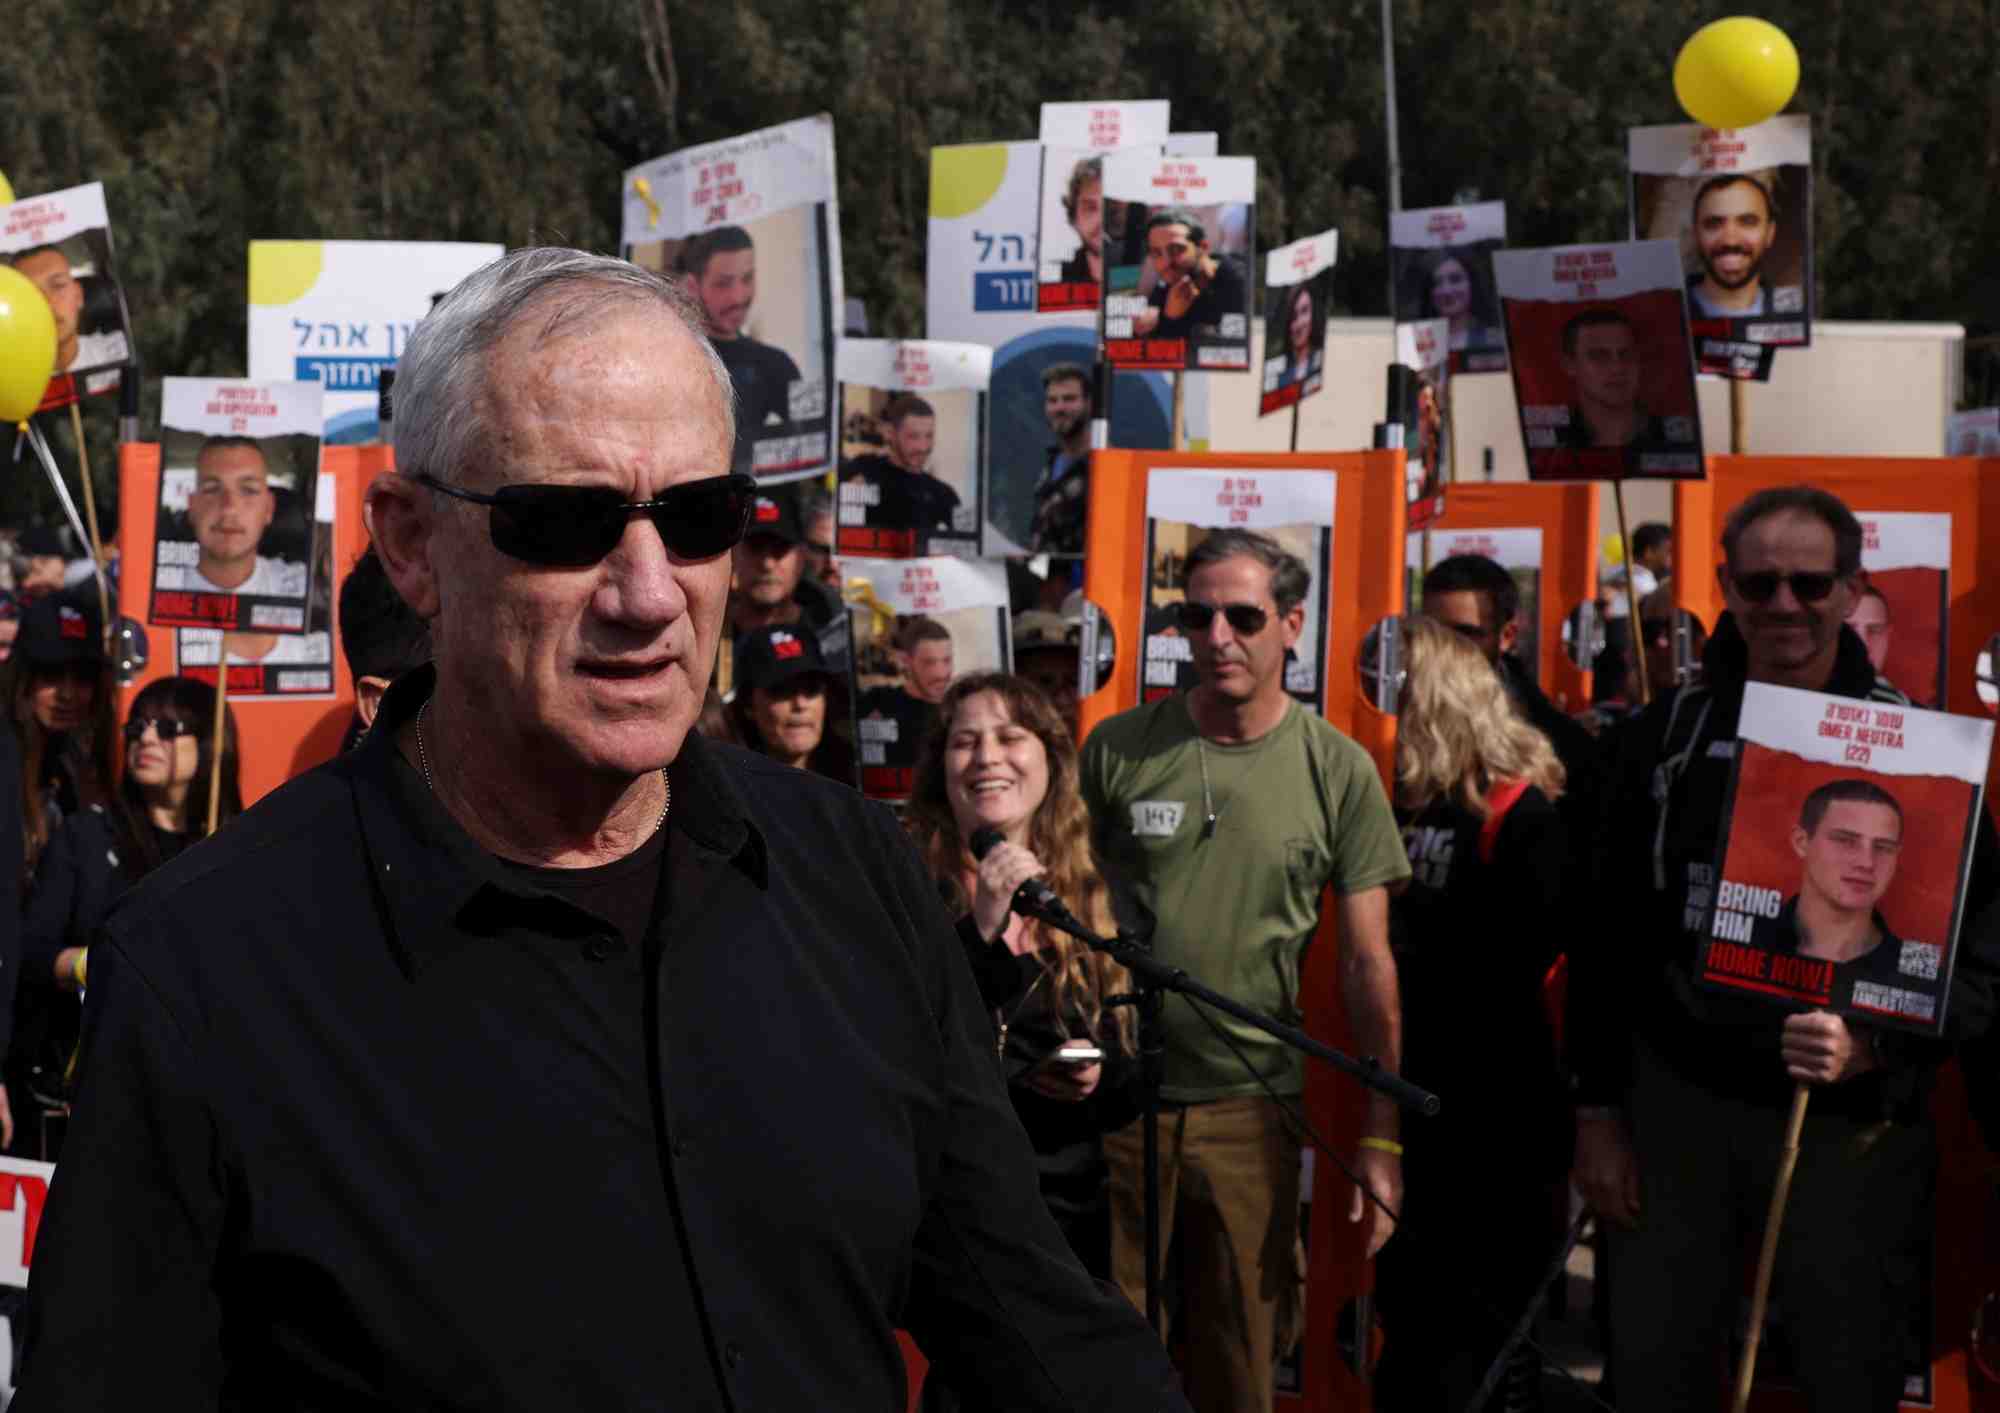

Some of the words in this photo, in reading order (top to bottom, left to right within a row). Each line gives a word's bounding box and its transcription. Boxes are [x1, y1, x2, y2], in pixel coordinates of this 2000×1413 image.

[293, 317, 368, 348] אהל
[1818, 720, 1852, 738] OMER
[1856, 728, 1905, 749] NEUTRA
[1717, 880, 1782, 919] BRING
[1712, 909, 1754, 944] HIM
[1706, 942, 1767, 979] HOME
[1769, 955, 1834, 993] NOW!
